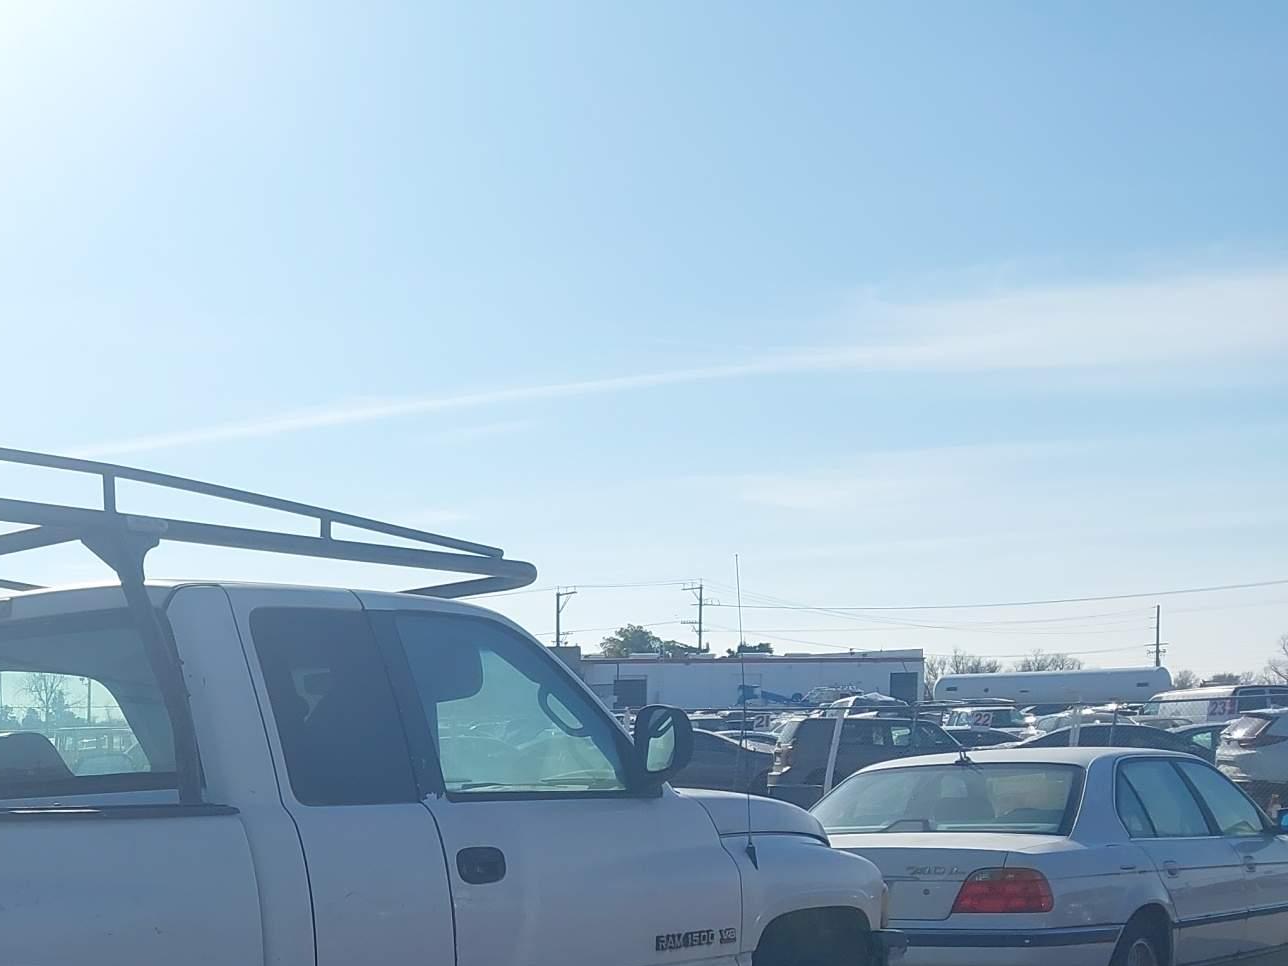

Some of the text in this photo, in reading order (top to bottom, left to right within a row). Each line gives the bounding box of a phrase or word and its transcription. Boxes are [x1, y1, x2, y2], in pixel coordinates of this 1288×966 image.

[1210, 700, 1227, 715] 23
[755, 715, 769, 728] 21
[974, 712, 991, 727] 22
[658, 929, 714, 950] RAM 1500
